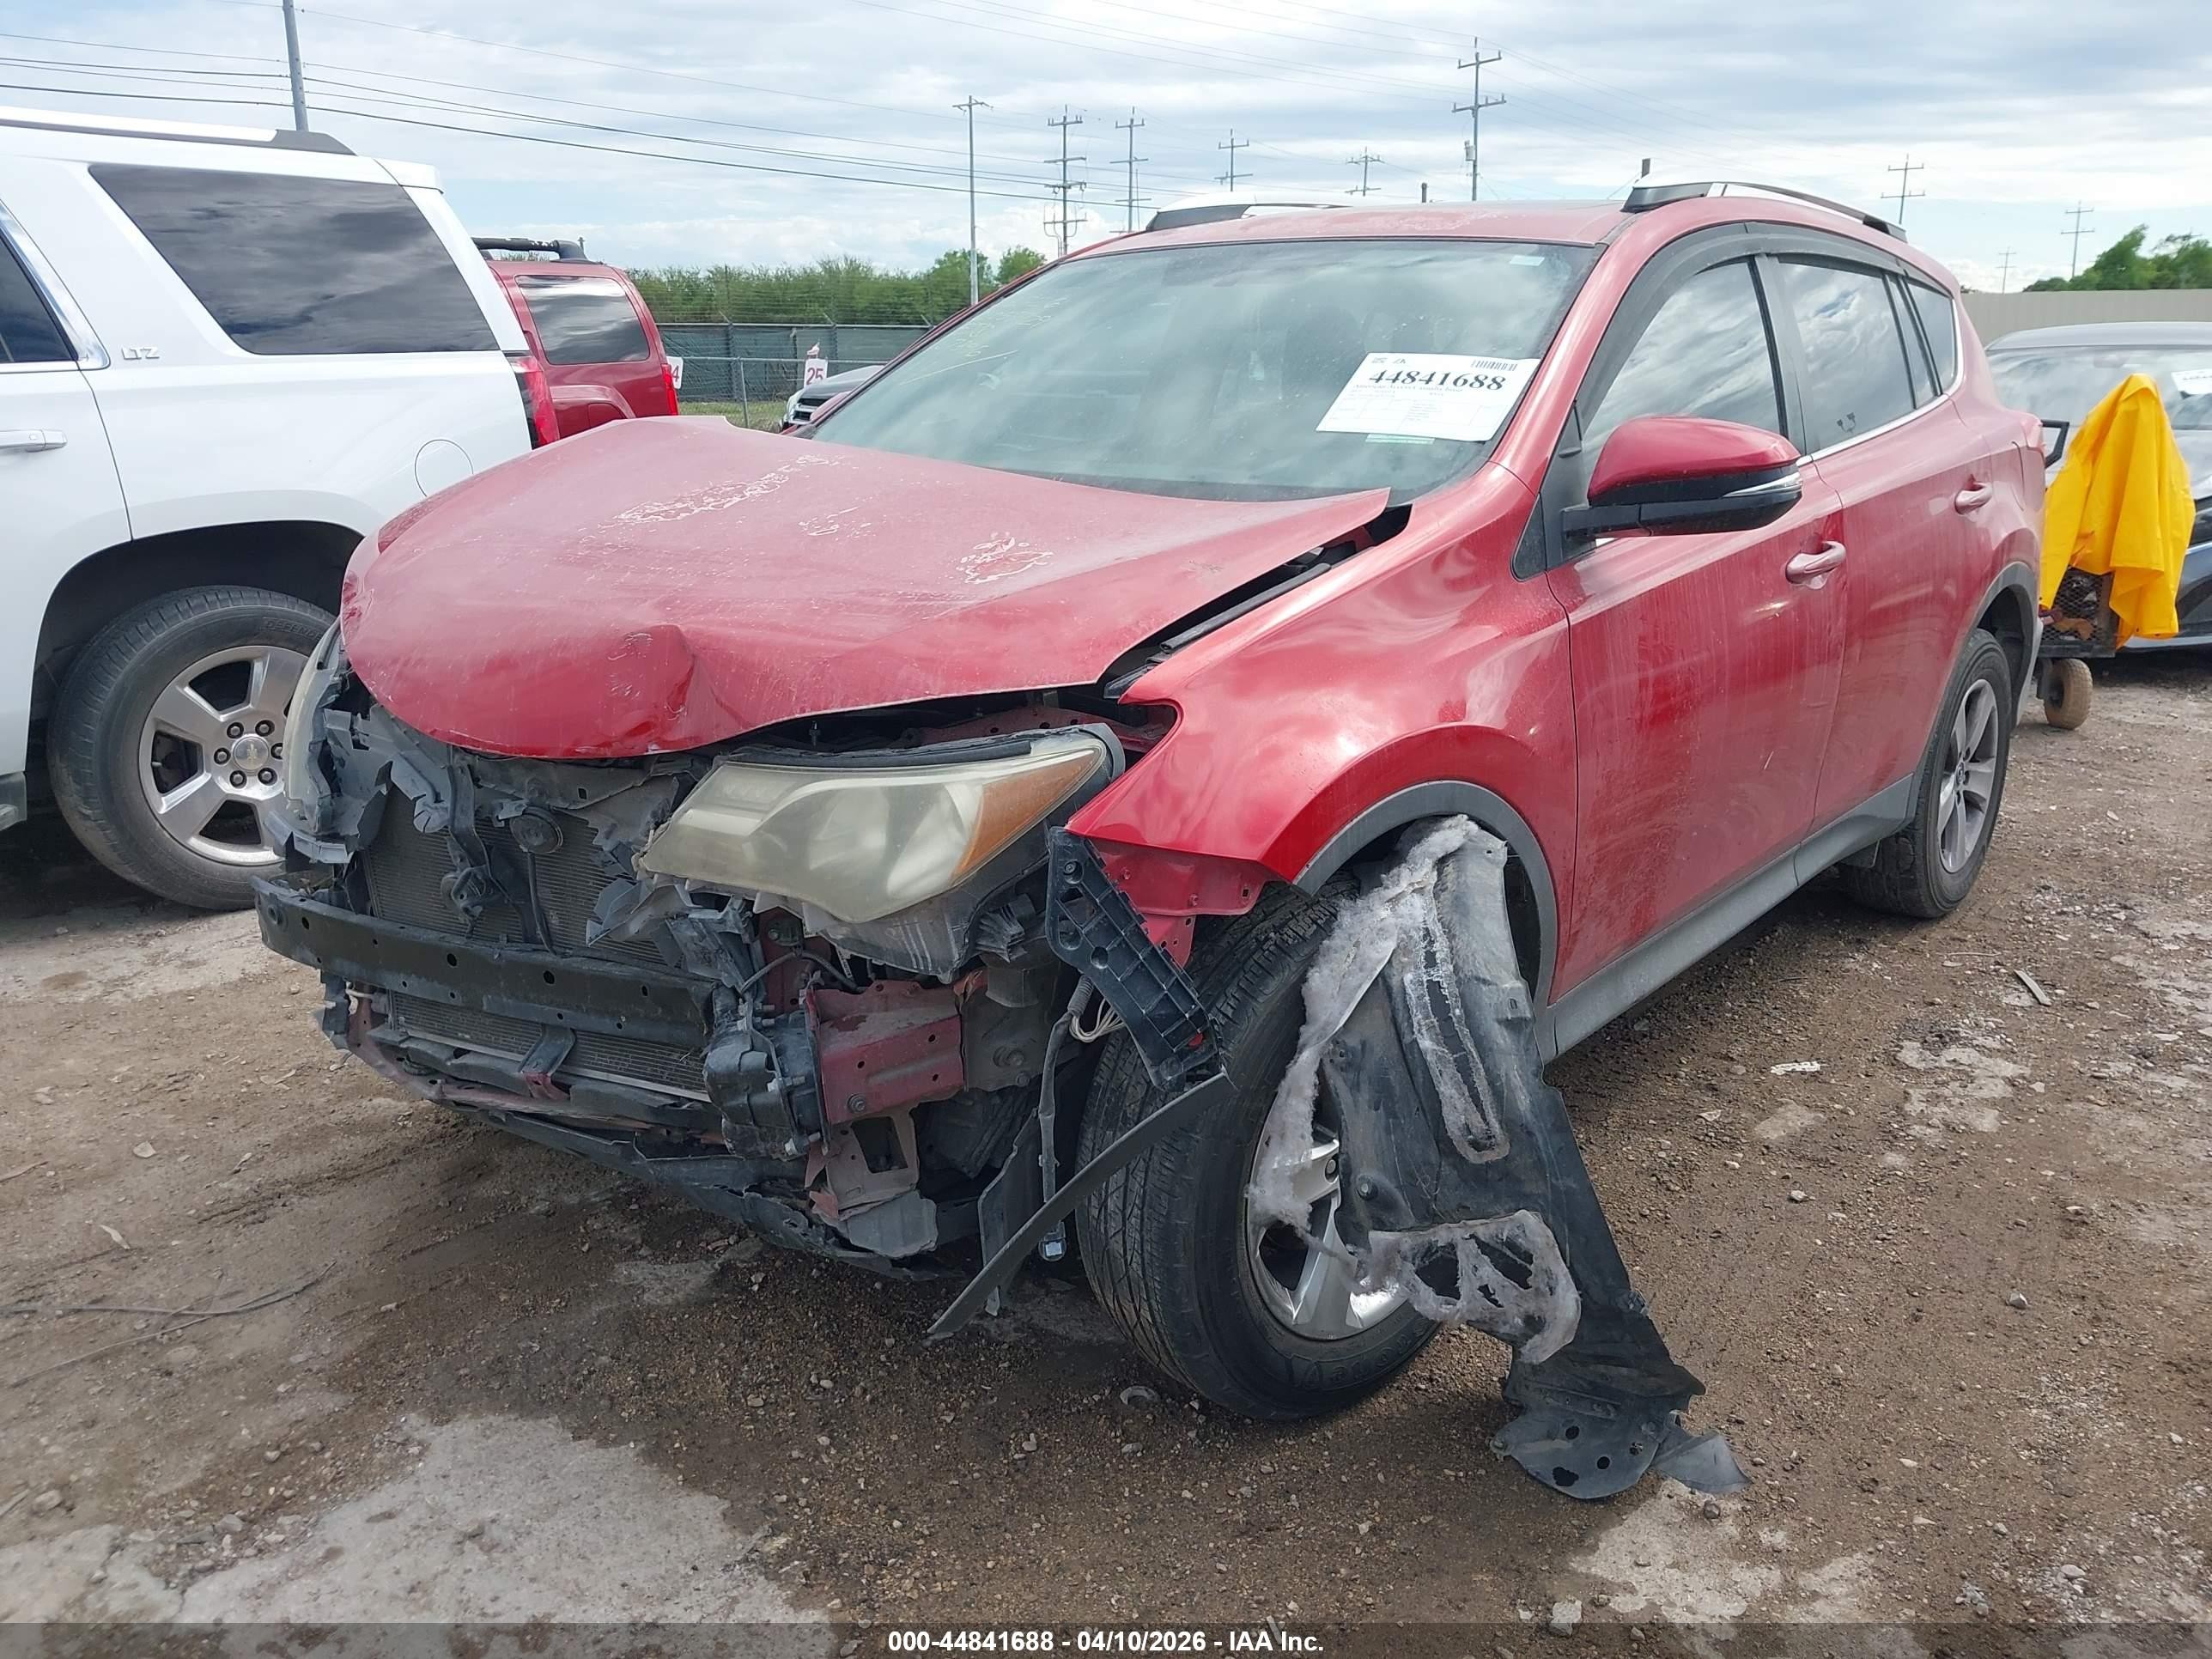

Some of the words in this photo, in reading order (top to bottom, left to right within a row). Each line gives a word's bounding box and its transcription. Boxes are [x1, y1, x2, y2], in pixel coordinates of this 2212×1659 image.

[121, 346, 160, 360] LTZ
[806, 367, 823, 385] 25
[1369, 369, 1506, 391] 44841688
